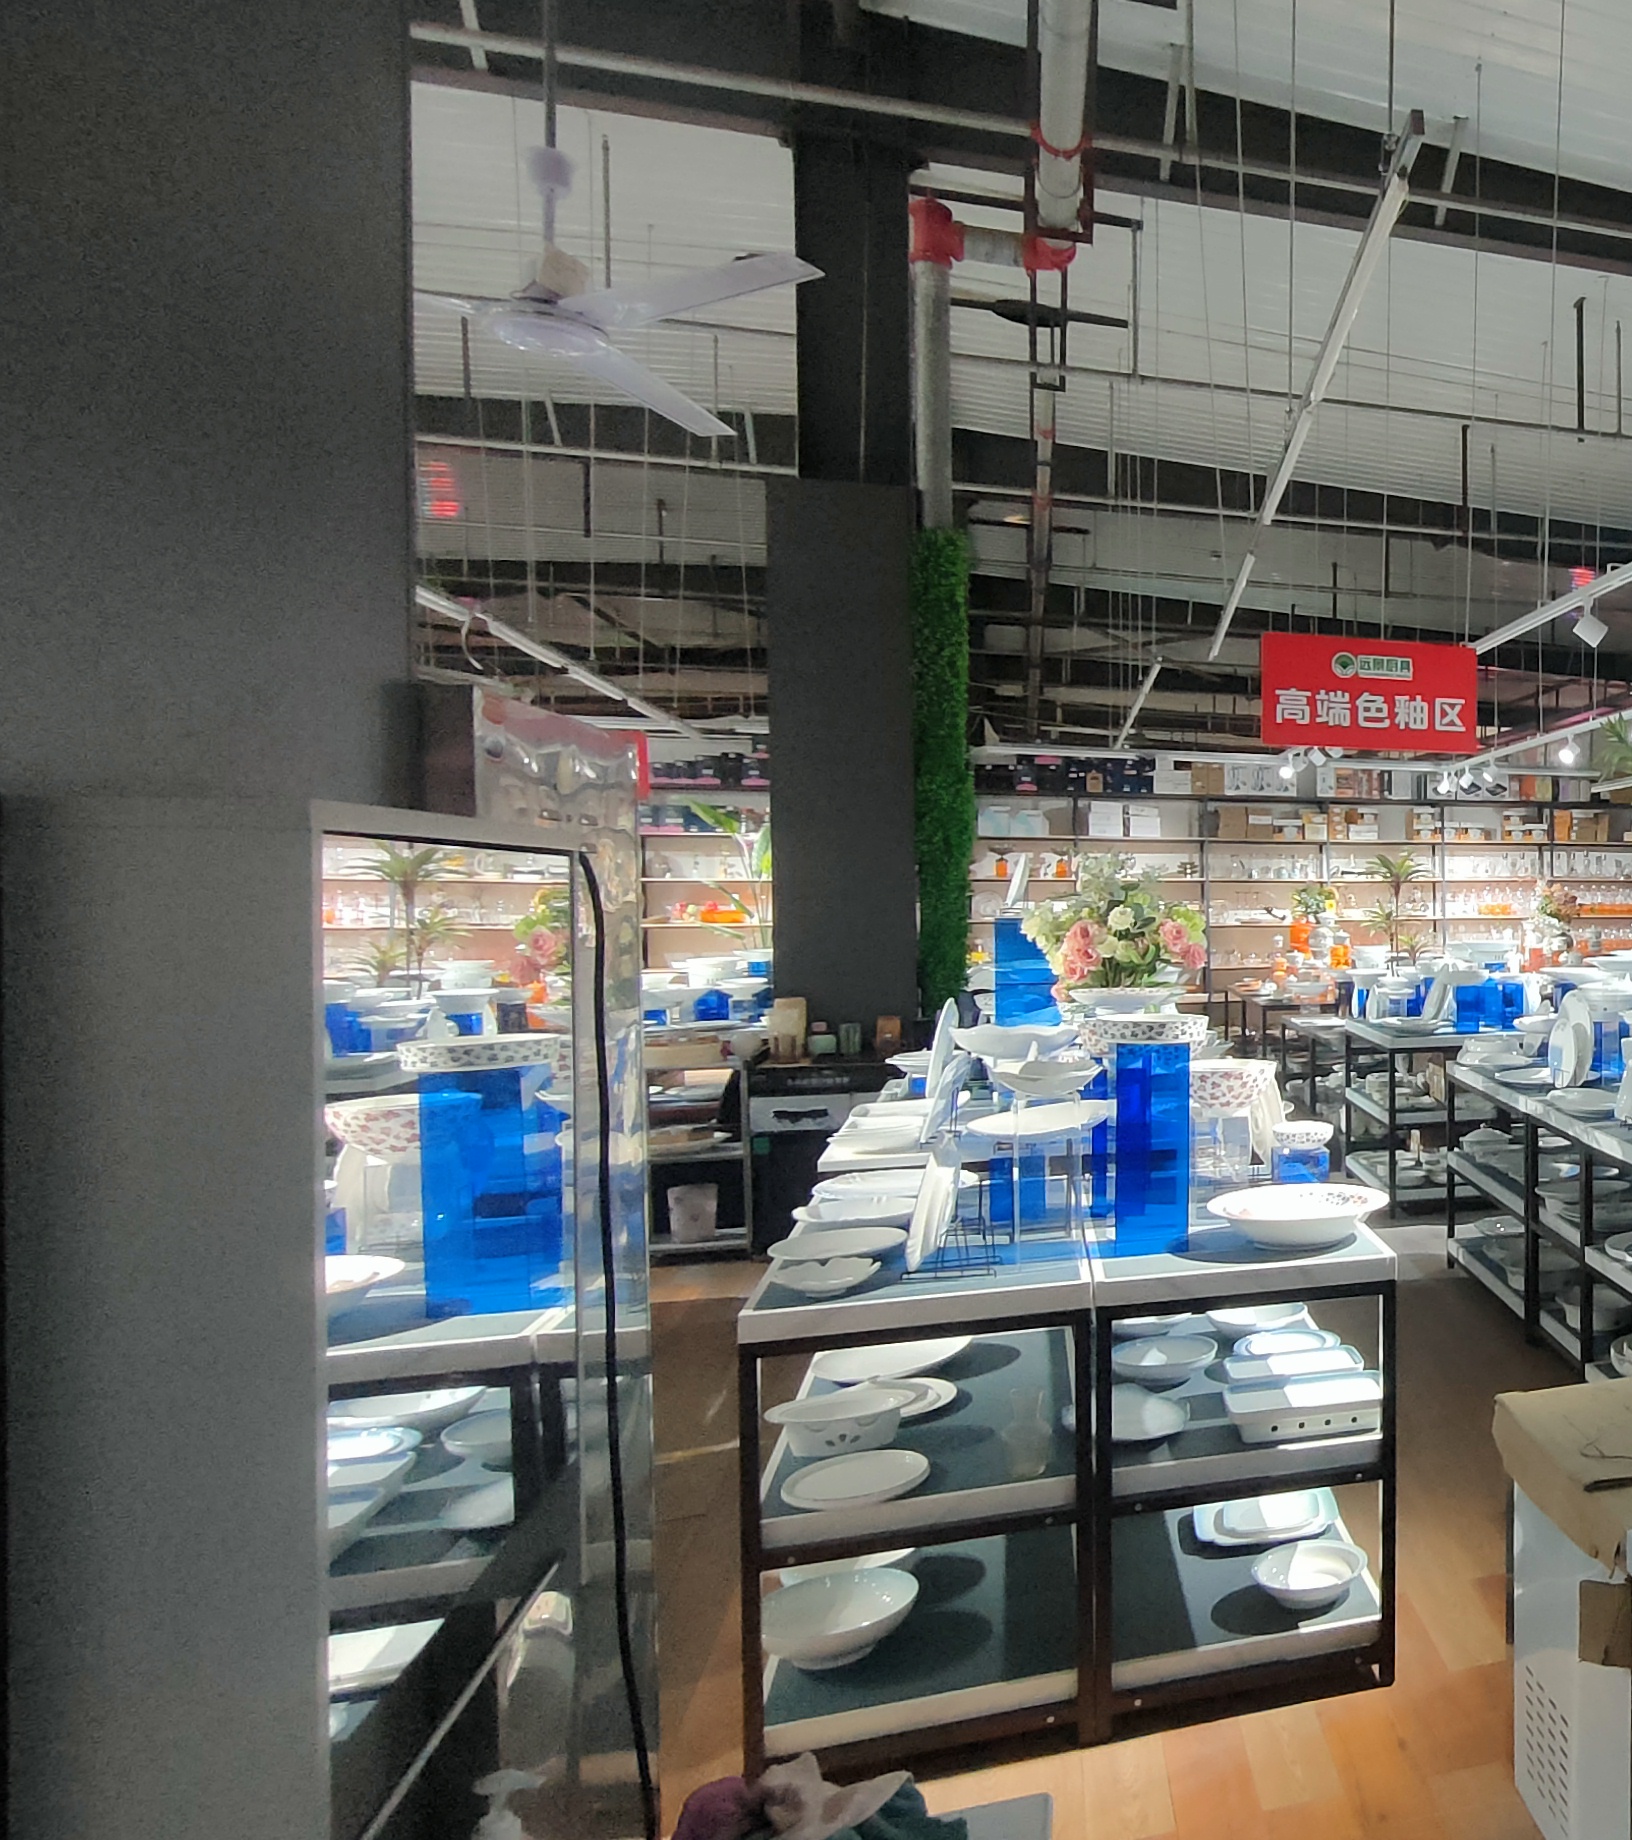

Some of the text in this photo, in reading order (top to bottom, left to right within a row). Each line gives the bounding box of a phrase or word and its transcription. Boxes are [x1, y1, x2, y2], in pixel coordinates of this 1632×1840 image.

[1274, 687, 1467, 732] 高端色釉区
